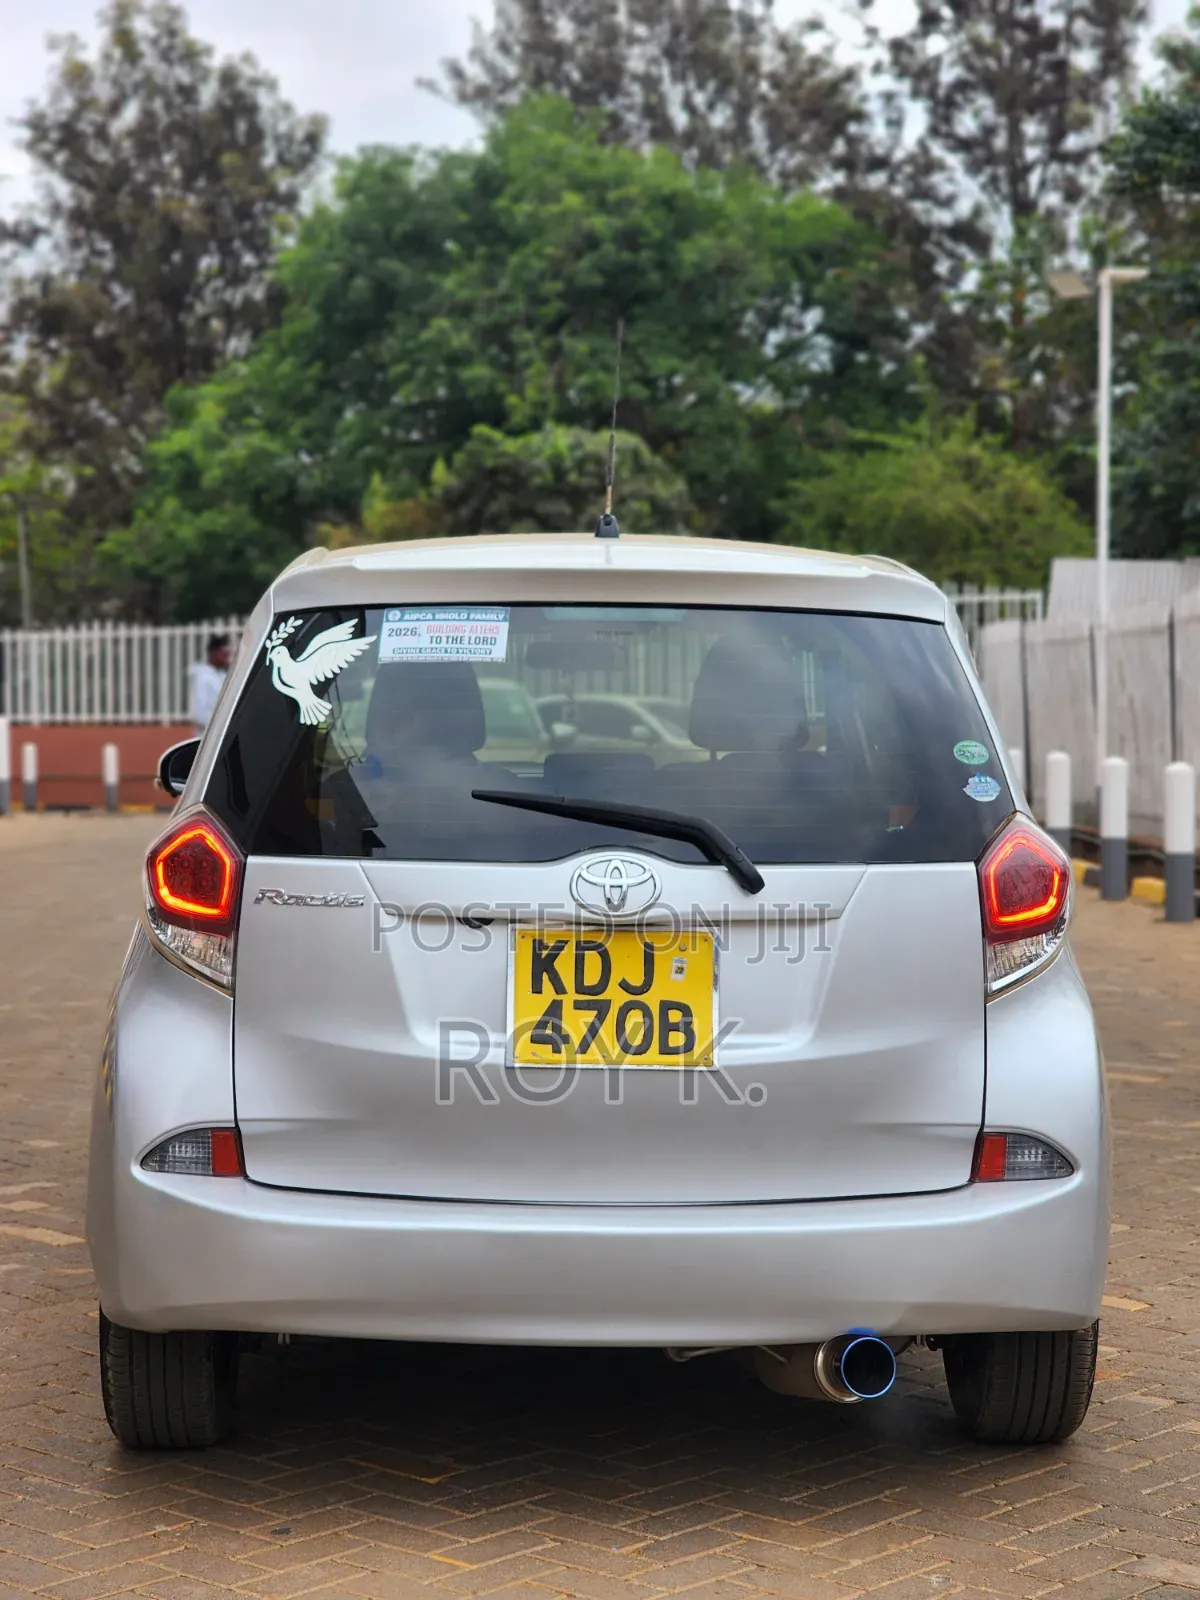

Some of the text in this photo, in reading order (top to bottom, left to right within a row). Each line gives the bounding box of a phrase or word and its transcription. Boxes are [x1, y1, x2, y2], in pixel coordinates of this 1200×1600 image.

[470, 612, 505, 621] FAMILY
[426, 623, 466, 635] BUILDING
[429, 635, 497, 646] TO THE LORD
[394, 647, 492, 656] DIVINE GRACE TO VICTORY
[253, 887, 366, 908] Ractis
[530, 938, 655, 996] KDJ
[530, 998, 697, 1056] 470B
